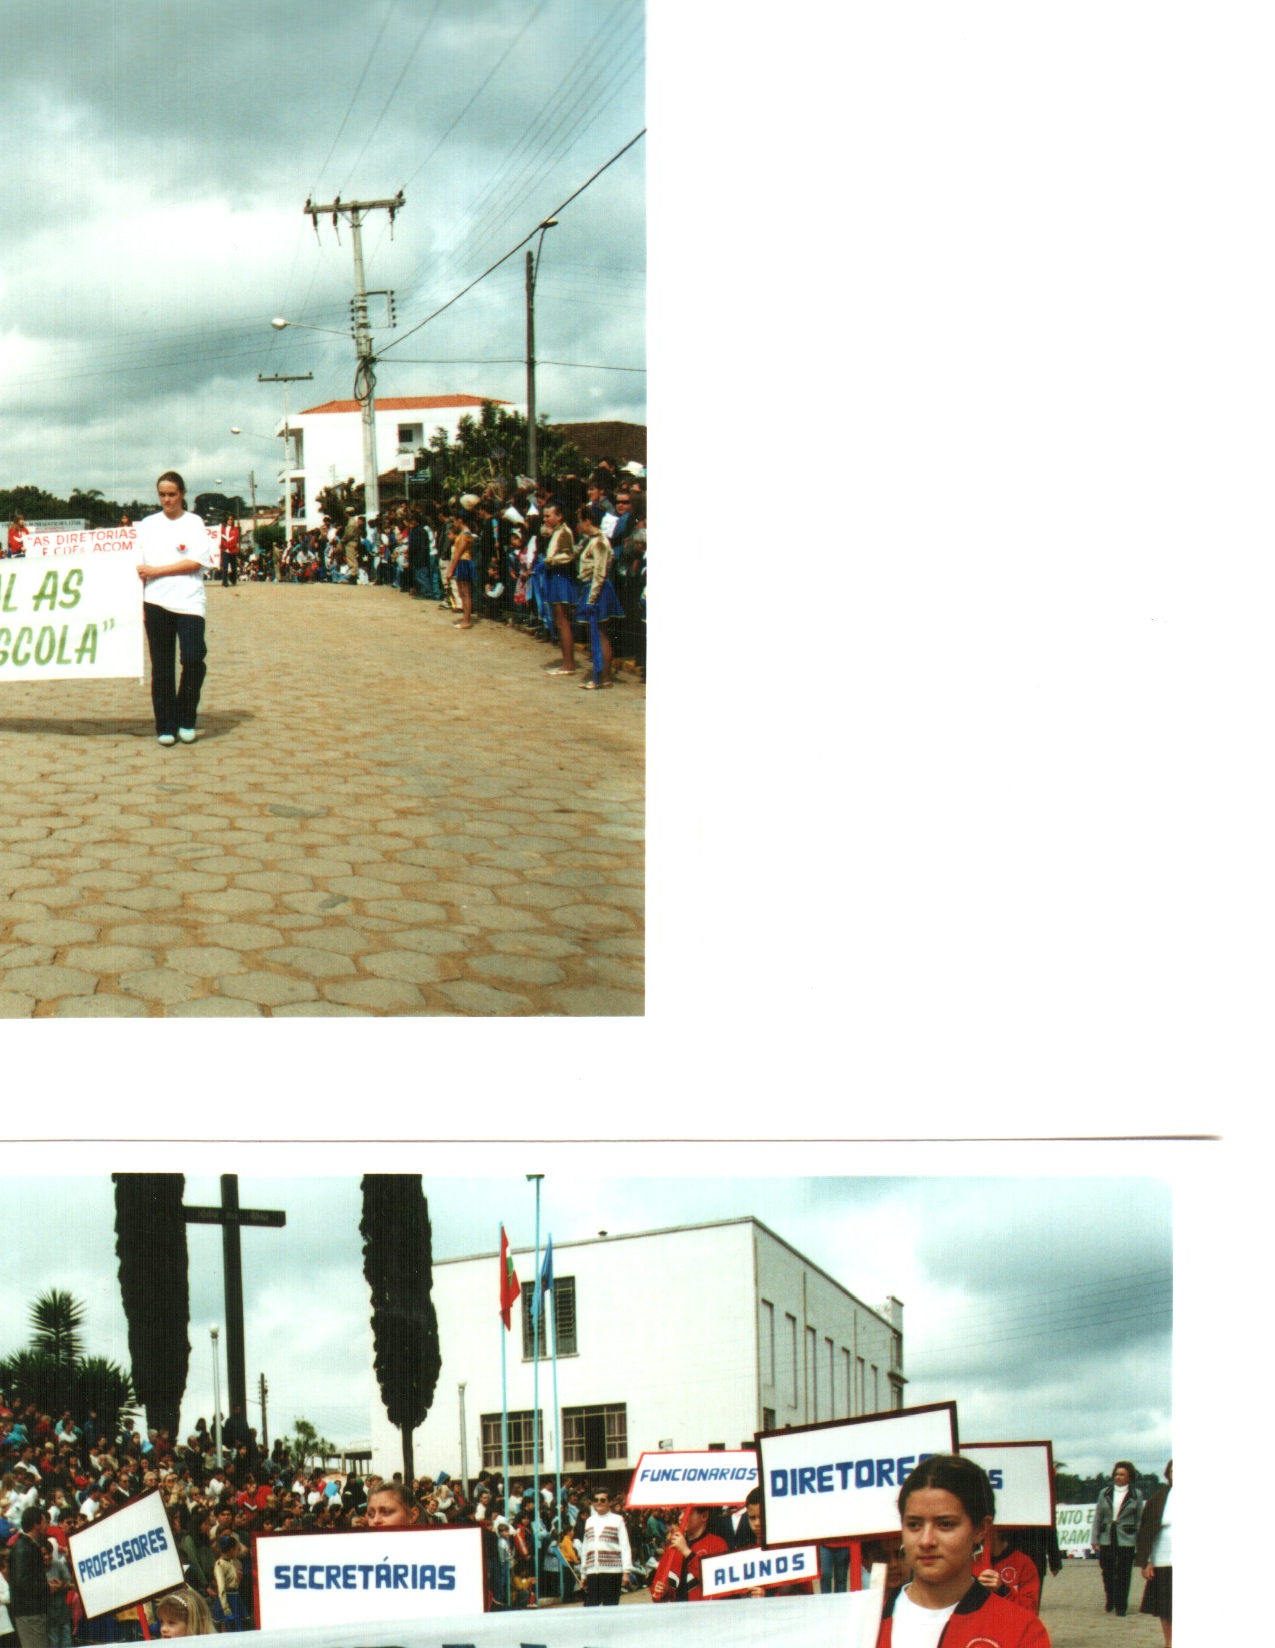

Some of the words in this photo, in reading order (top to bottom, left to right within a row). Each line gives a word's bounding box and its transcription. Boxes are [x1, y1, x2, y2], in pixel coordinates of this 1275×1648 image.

[27, 536, 50, 547] "AS
[56, 528, 137, 545] DIRETORIAS
[92, 541, 135, 552] ACOM
[32, 568, 84, 612] AS
[640, 1467, 757, 1482] FUNCIONARIOS
[770, 1453, 933, 1498] DIRETORE
[77, 1526, 169, 1583] PROFESSORES
[274, 1555, 456, 1591] SECRETÁRIAS
[713, 1552, 806, 1586] ALUNOS
